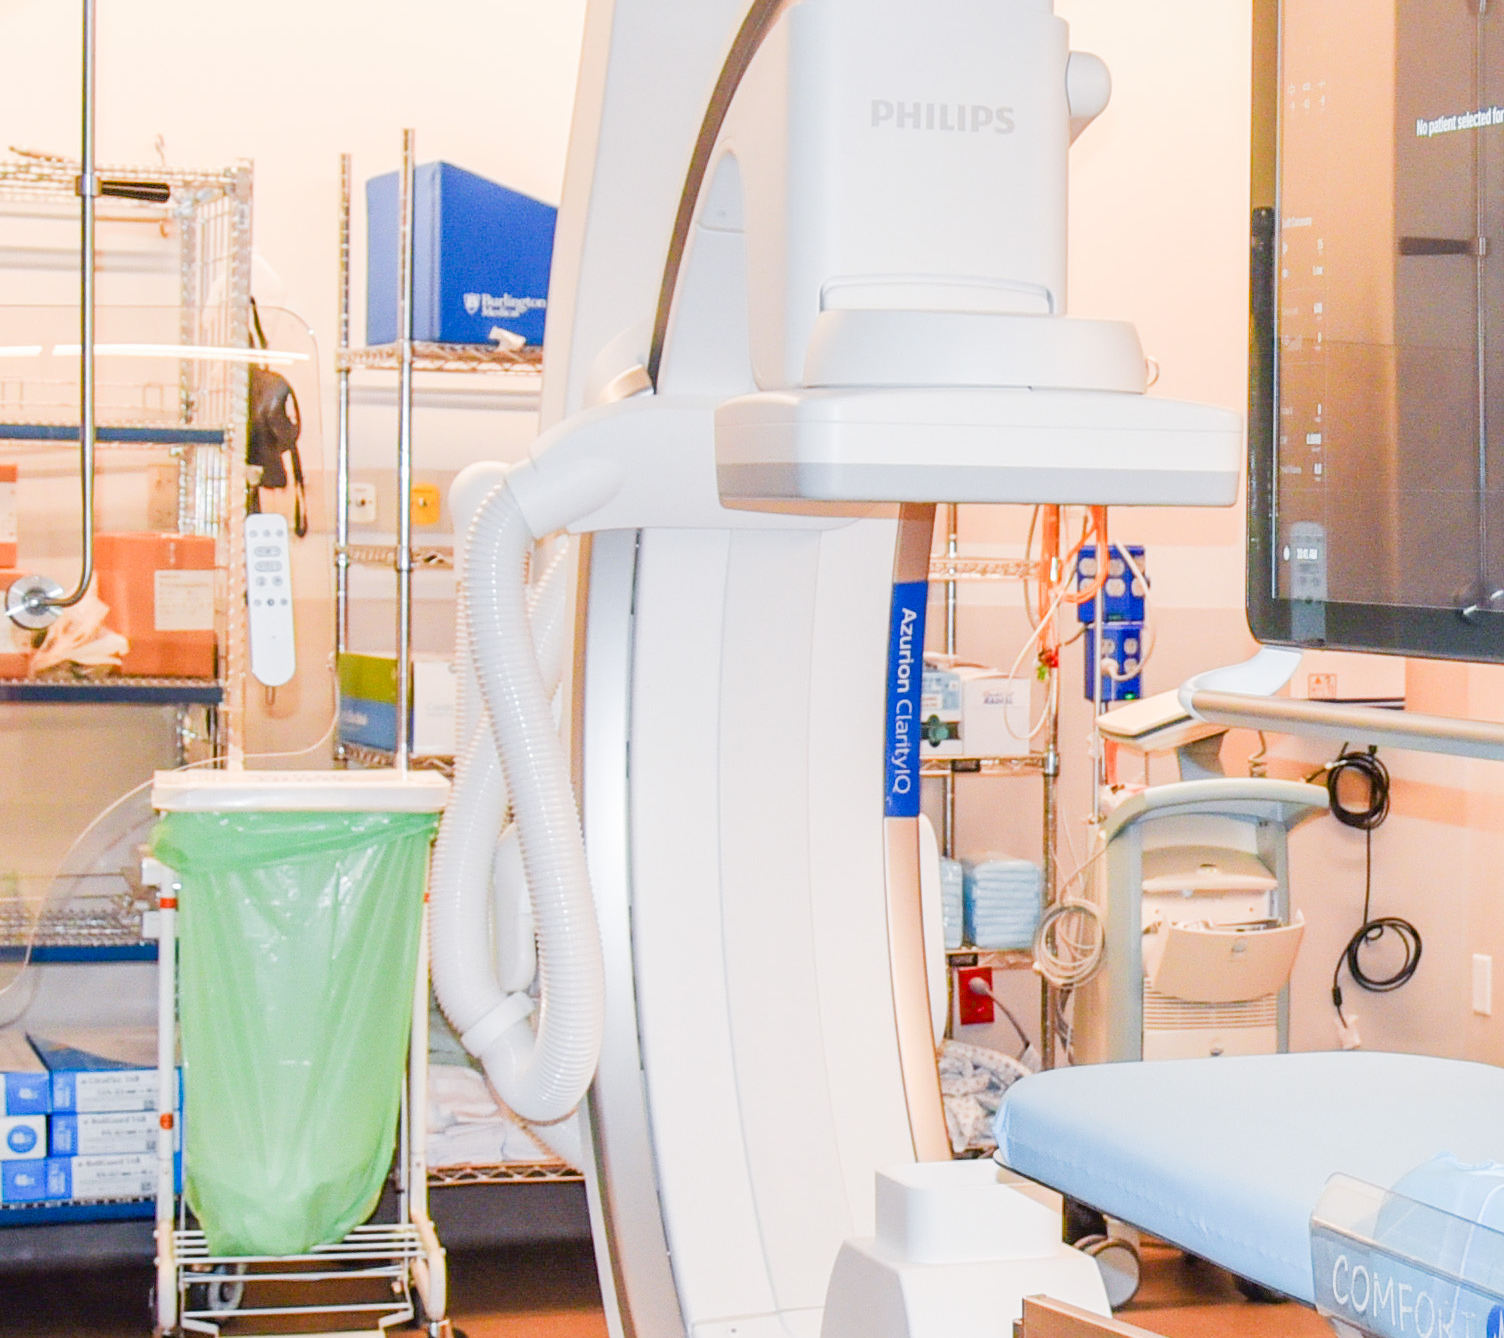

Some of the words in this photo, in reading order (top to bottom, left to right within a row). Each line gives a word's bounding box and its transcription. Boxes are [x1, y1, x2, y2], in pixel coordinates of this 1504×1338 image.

[871, 99, 1015, 135] PHILIPS
[1416, 119, 1427, 136] No
[1429, 115, 1456, 137] patient
[1458, 107, 1491, 129] selected
[1492, 106, 1504, 124] for
[897, 607, 917, 694] Azurion
[891, 699, 913, 795] ClarityIQ
